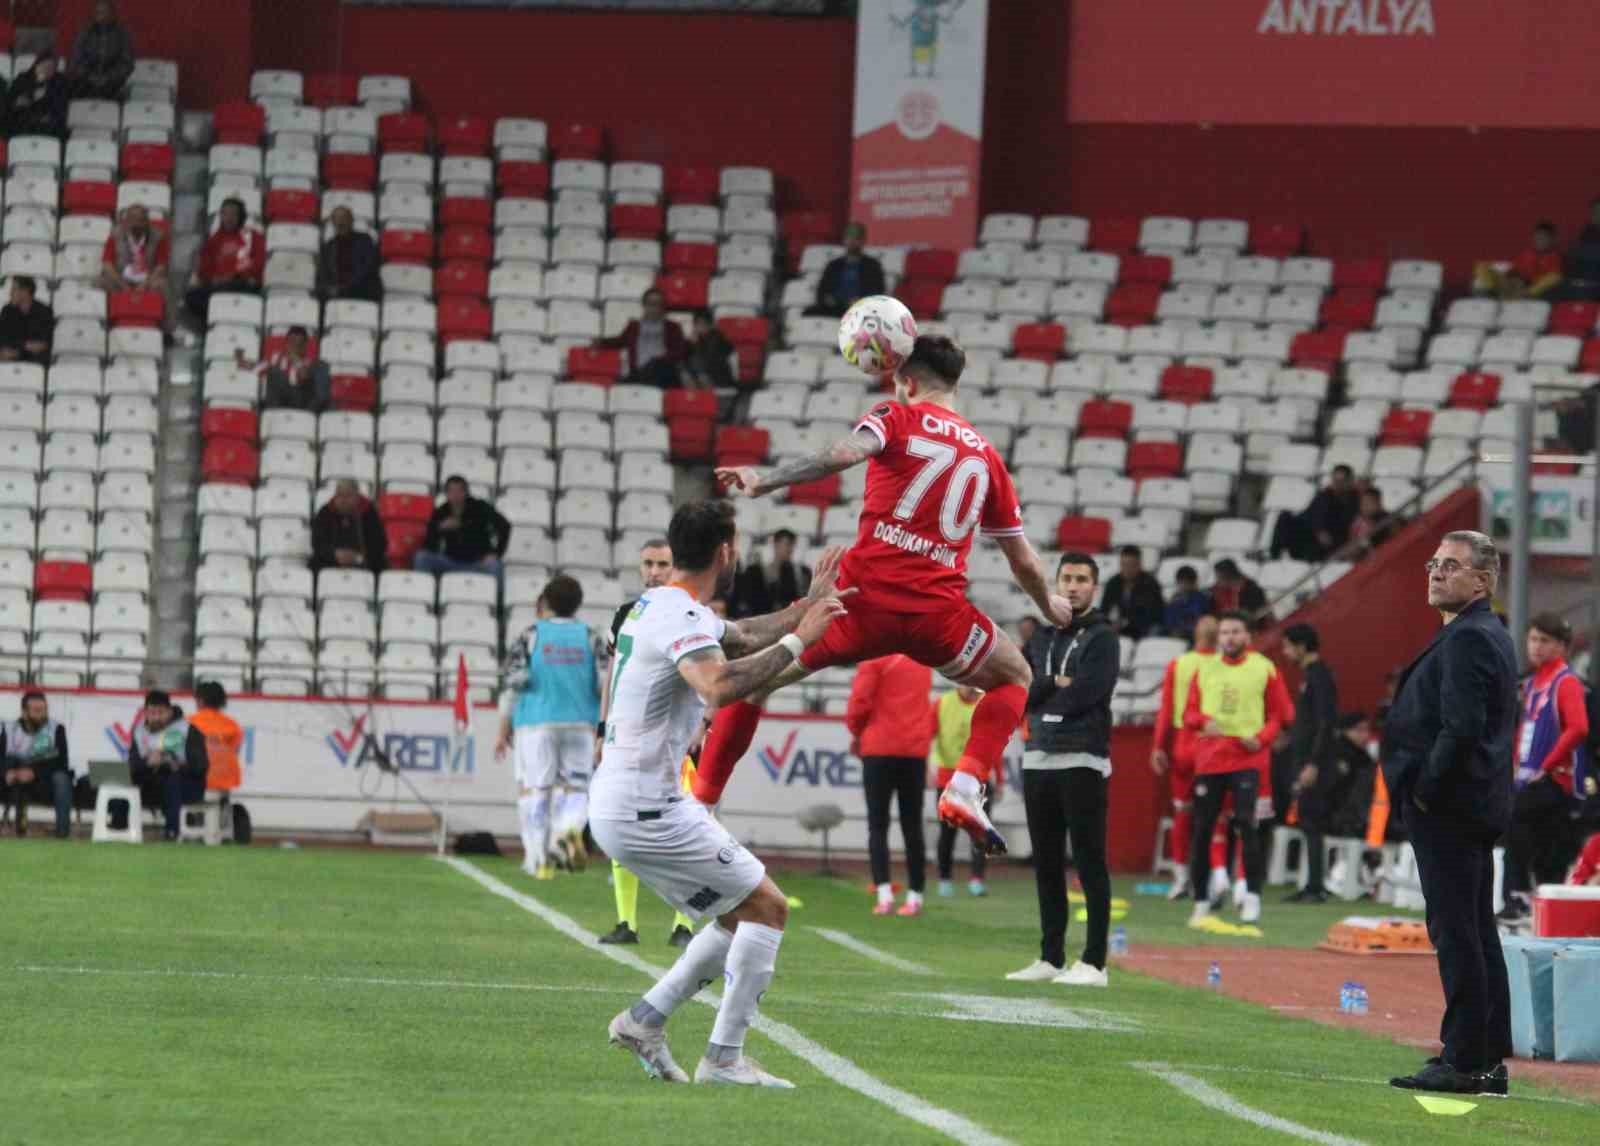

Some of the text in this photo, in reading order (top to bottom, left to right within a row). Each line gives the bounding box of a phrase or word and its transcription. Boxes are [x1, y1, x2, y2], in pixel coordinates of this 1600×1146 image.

[1257, 0, 1437, 36] ANTALYA
[892, 435, 990, 545] 70
[873, 519, 934, 557] DOĞUKAN
[756, 729, 864, 787] VARE
